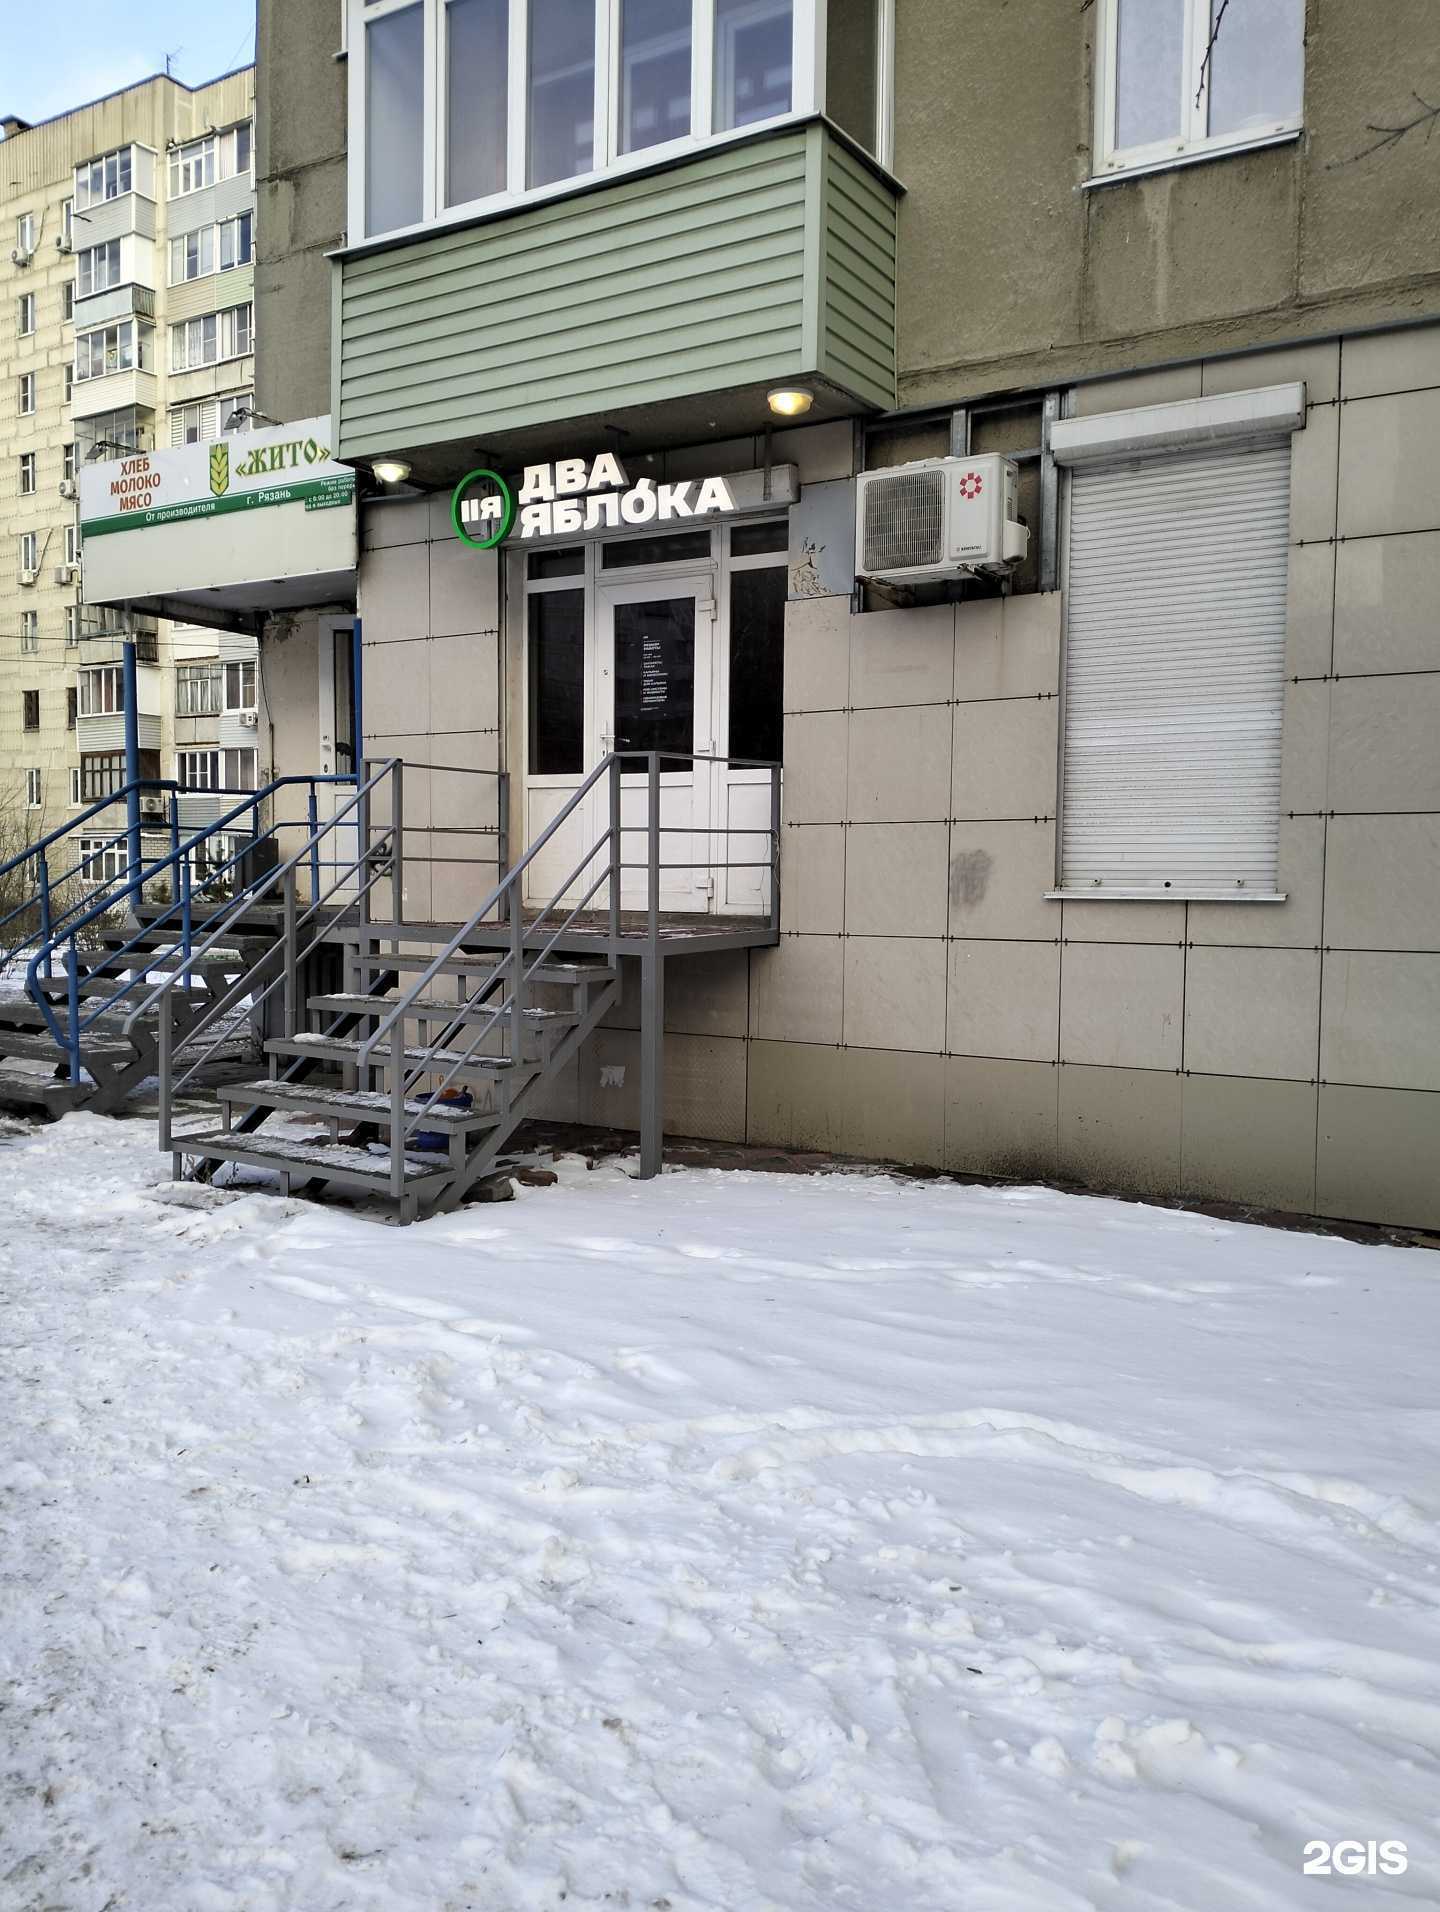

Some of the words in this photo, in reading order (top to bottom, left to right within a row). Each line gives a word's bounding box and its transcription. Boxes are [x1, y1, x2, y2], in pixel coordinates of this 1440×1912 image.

[120, 457, 151, 476] ХЛЕБ
[235, 437, 331, 477] «ЖИТО»
[110, 473, 161, 496] МОЛОКО
[518, 452, 627, 504] ДВА
[119, 491, 153, 512] МЯСО
[246, 496, 254, 505] г.
[258, 489, 292, 503] Рязань
[145, 512, 155, 522] От
[156, 502, 216, 520] производителя
